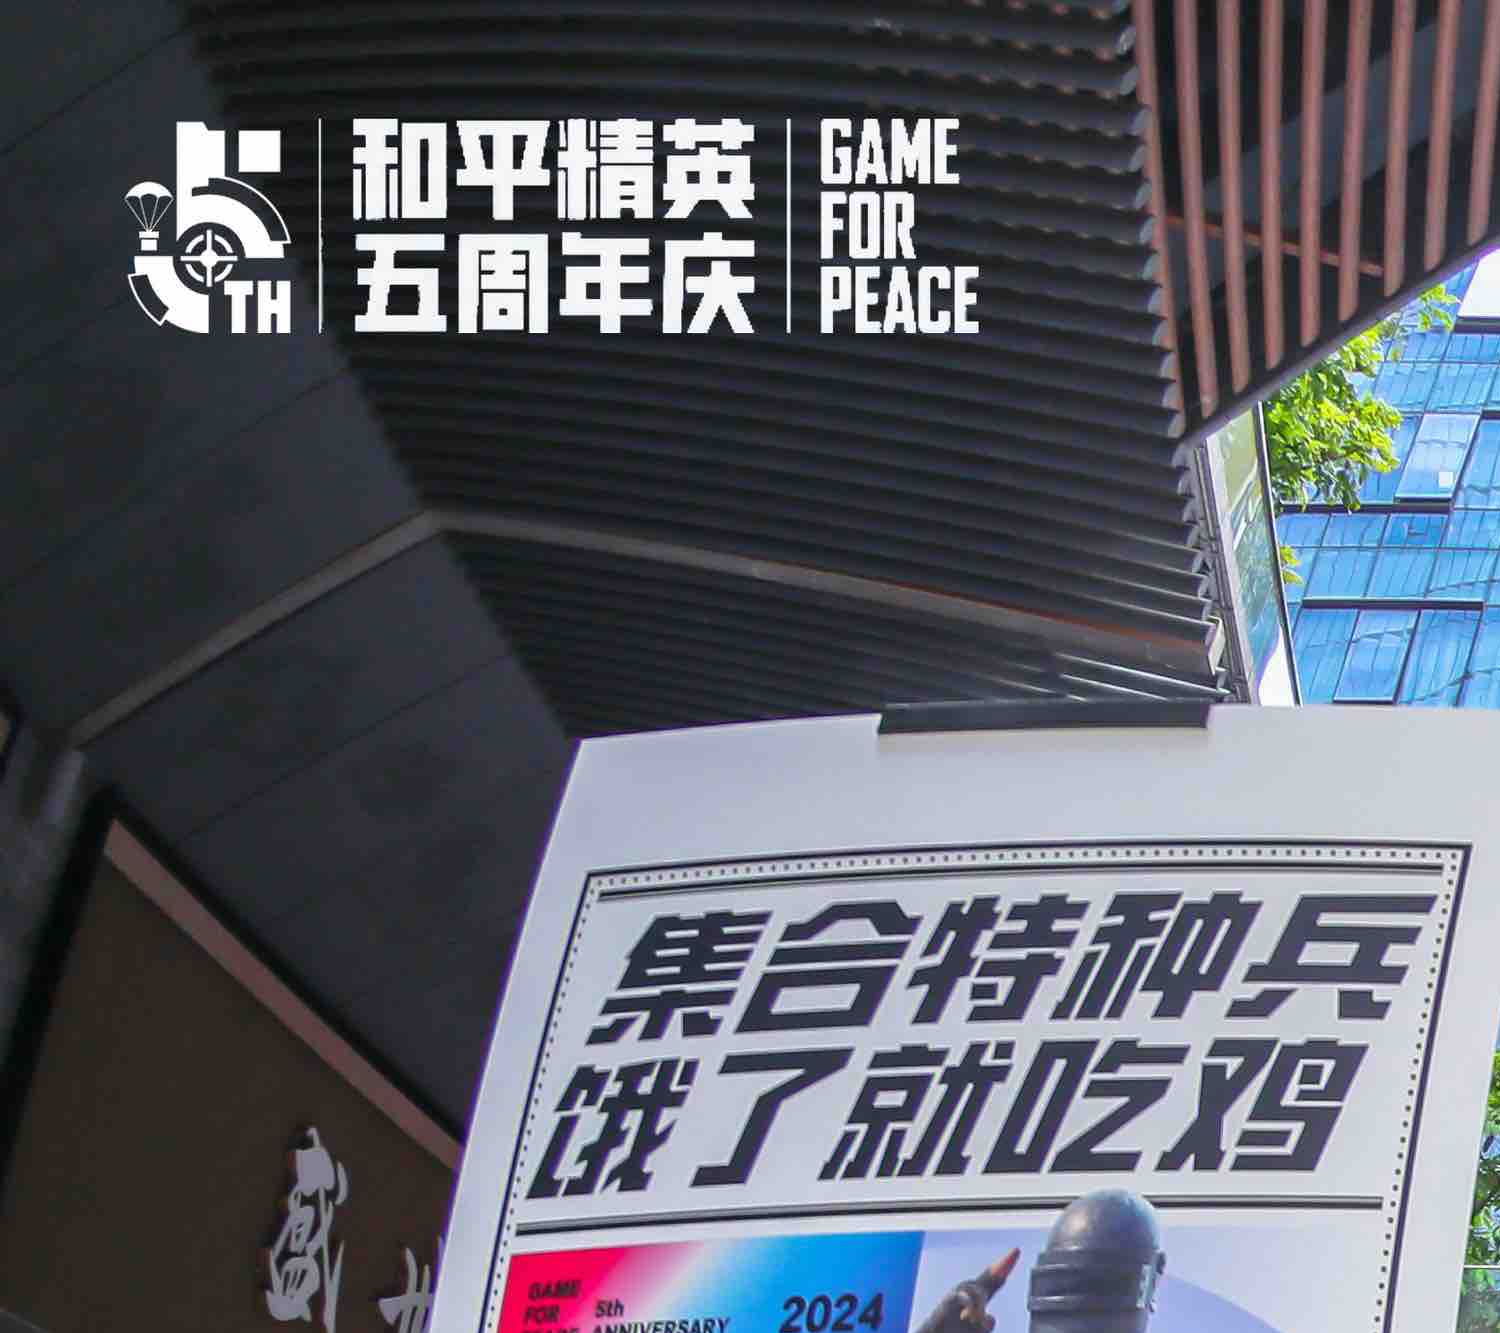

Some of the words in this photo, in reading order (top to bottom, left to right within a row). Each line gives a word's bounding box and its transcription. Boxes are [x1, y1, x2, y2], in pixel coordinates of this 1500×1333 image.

[587, 890, 1439, 1046] 集合特种兵
[526, 1036, 1371, 1198] 饿了就吃鸡
[524, 1305, 561, 1325] FOR
[593, 1298, 625, 1319] 5th
[527, 1279, 583, 1302] GAME
